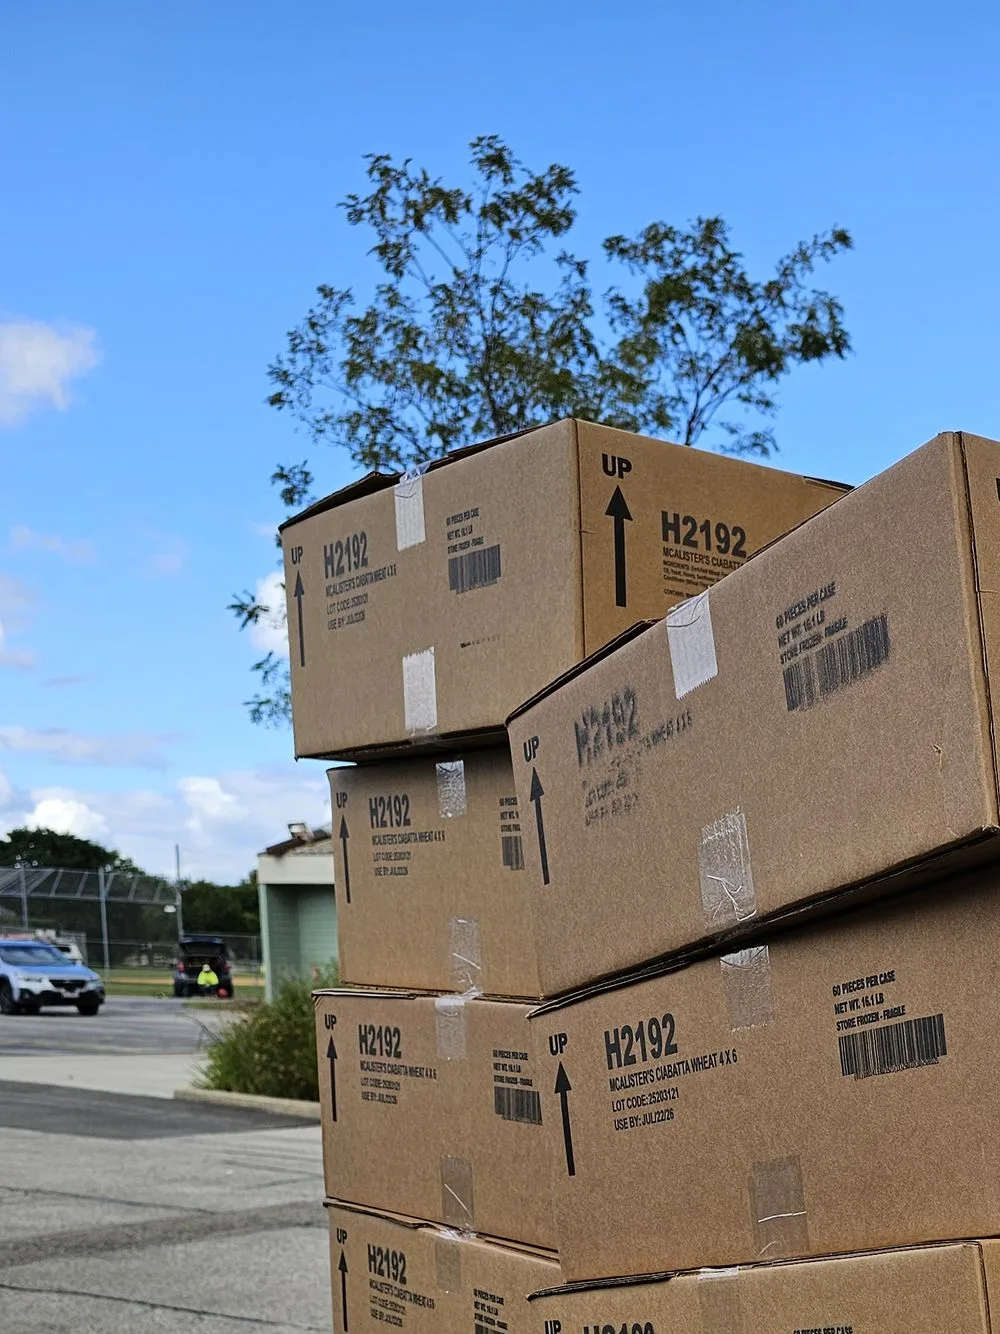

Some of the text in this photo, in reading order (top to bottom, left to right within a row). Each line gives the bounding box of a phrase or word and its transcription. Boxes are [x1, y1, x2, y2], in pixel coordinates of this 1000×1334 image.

[602, 453, 632, 479] UP
[661, 510, 747, 558] H2192
[291, 546, 303, 565] UP
[323, 530, 368, 579] H2192
[663, 547, 711, 566] MCALISTER'S
[524, 736, 539, 762] UP
[336, 792, 348, 808] UP
[369, 794, 411, 829] H2192
[832, 970, 896, 997] 60 PIECES PER CASE
[834, 992, 884, 1015] NET WT. 16.1 LB
[325, 1014, 336, 1030] UP
[836, 1005, 906, 1031] STORE FROZEN FRAGILE
[357, 1023, 402, 1059] H2192
[549, 1033, 567, 1055] UP
[603, 1012, 678, 1070] H2192
[609, 1069, 655, 1092] MCALISTER'S
[655, 1060, 691, 1081] CIABATTA
[690, 1053, 717, 1072] WHEAT
[724, 1049, 732, 1065] X
[732, 1048, 738, 1063] 6
[611, 1098, 625, 1113] LOT
[614, 1117, 629, 1131] USE
[337, 1228, 347, 1244] UP
[367, 1243, 407, 1285] H2192
